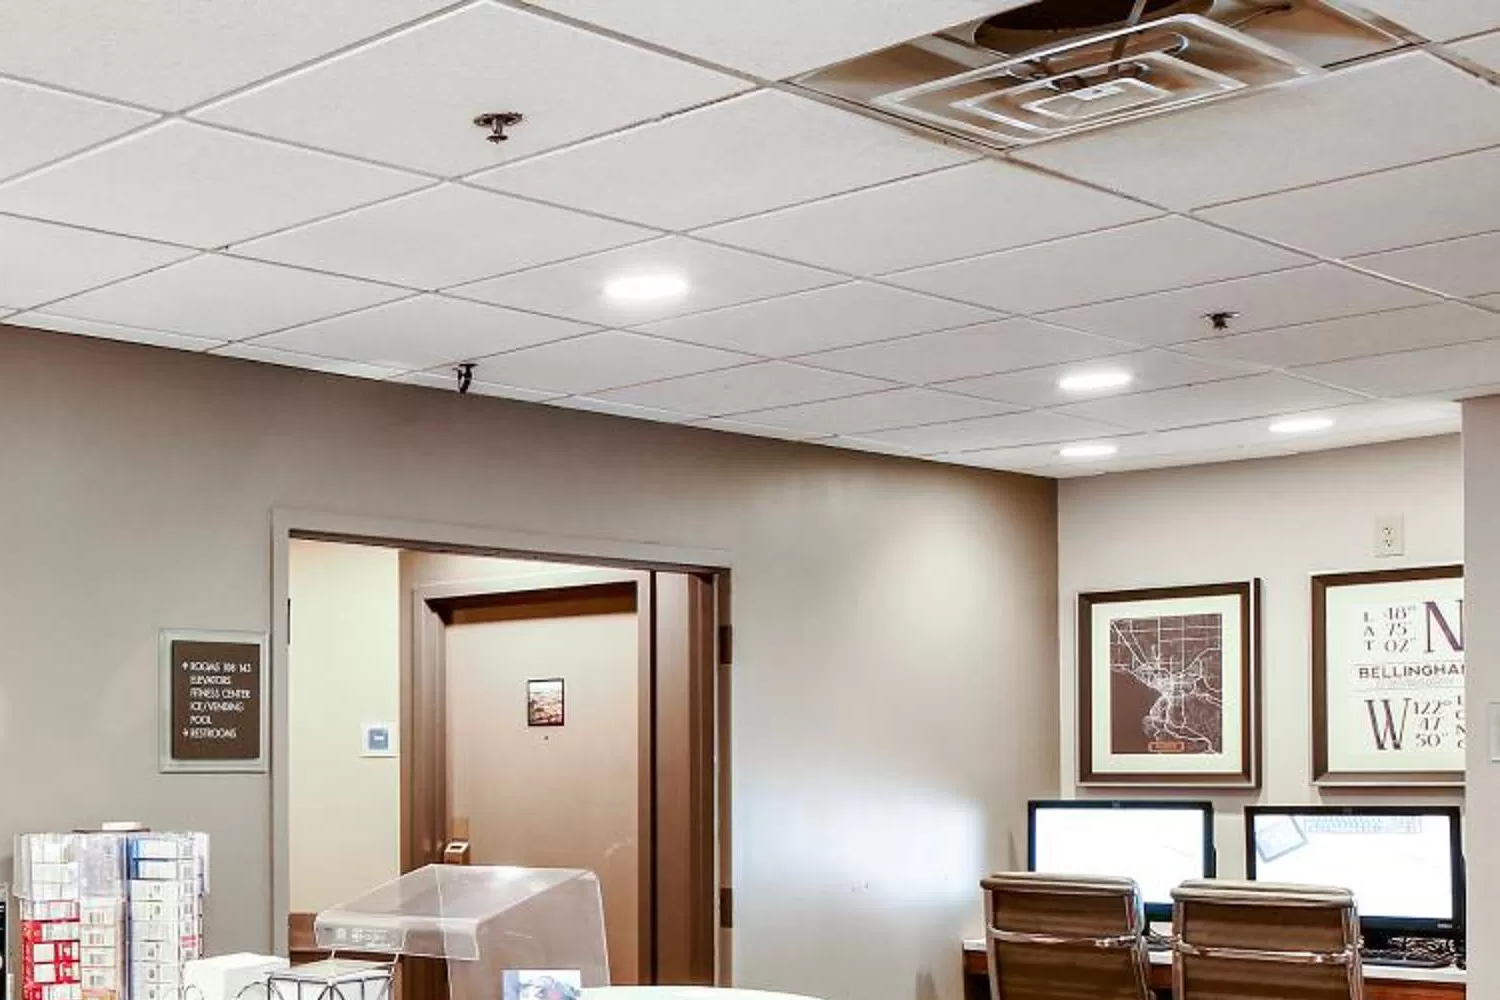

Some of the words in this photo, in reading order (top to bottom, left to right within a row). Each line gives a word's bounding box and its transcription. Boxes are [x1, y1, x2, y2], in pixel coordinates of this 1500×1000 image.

[1422, 600, 1464, 652] N
[1358, 664, 1464, 679] BELLINGHA
[189, 715, 212, 725] POOL
[1363, 697, 1412, 750] W
